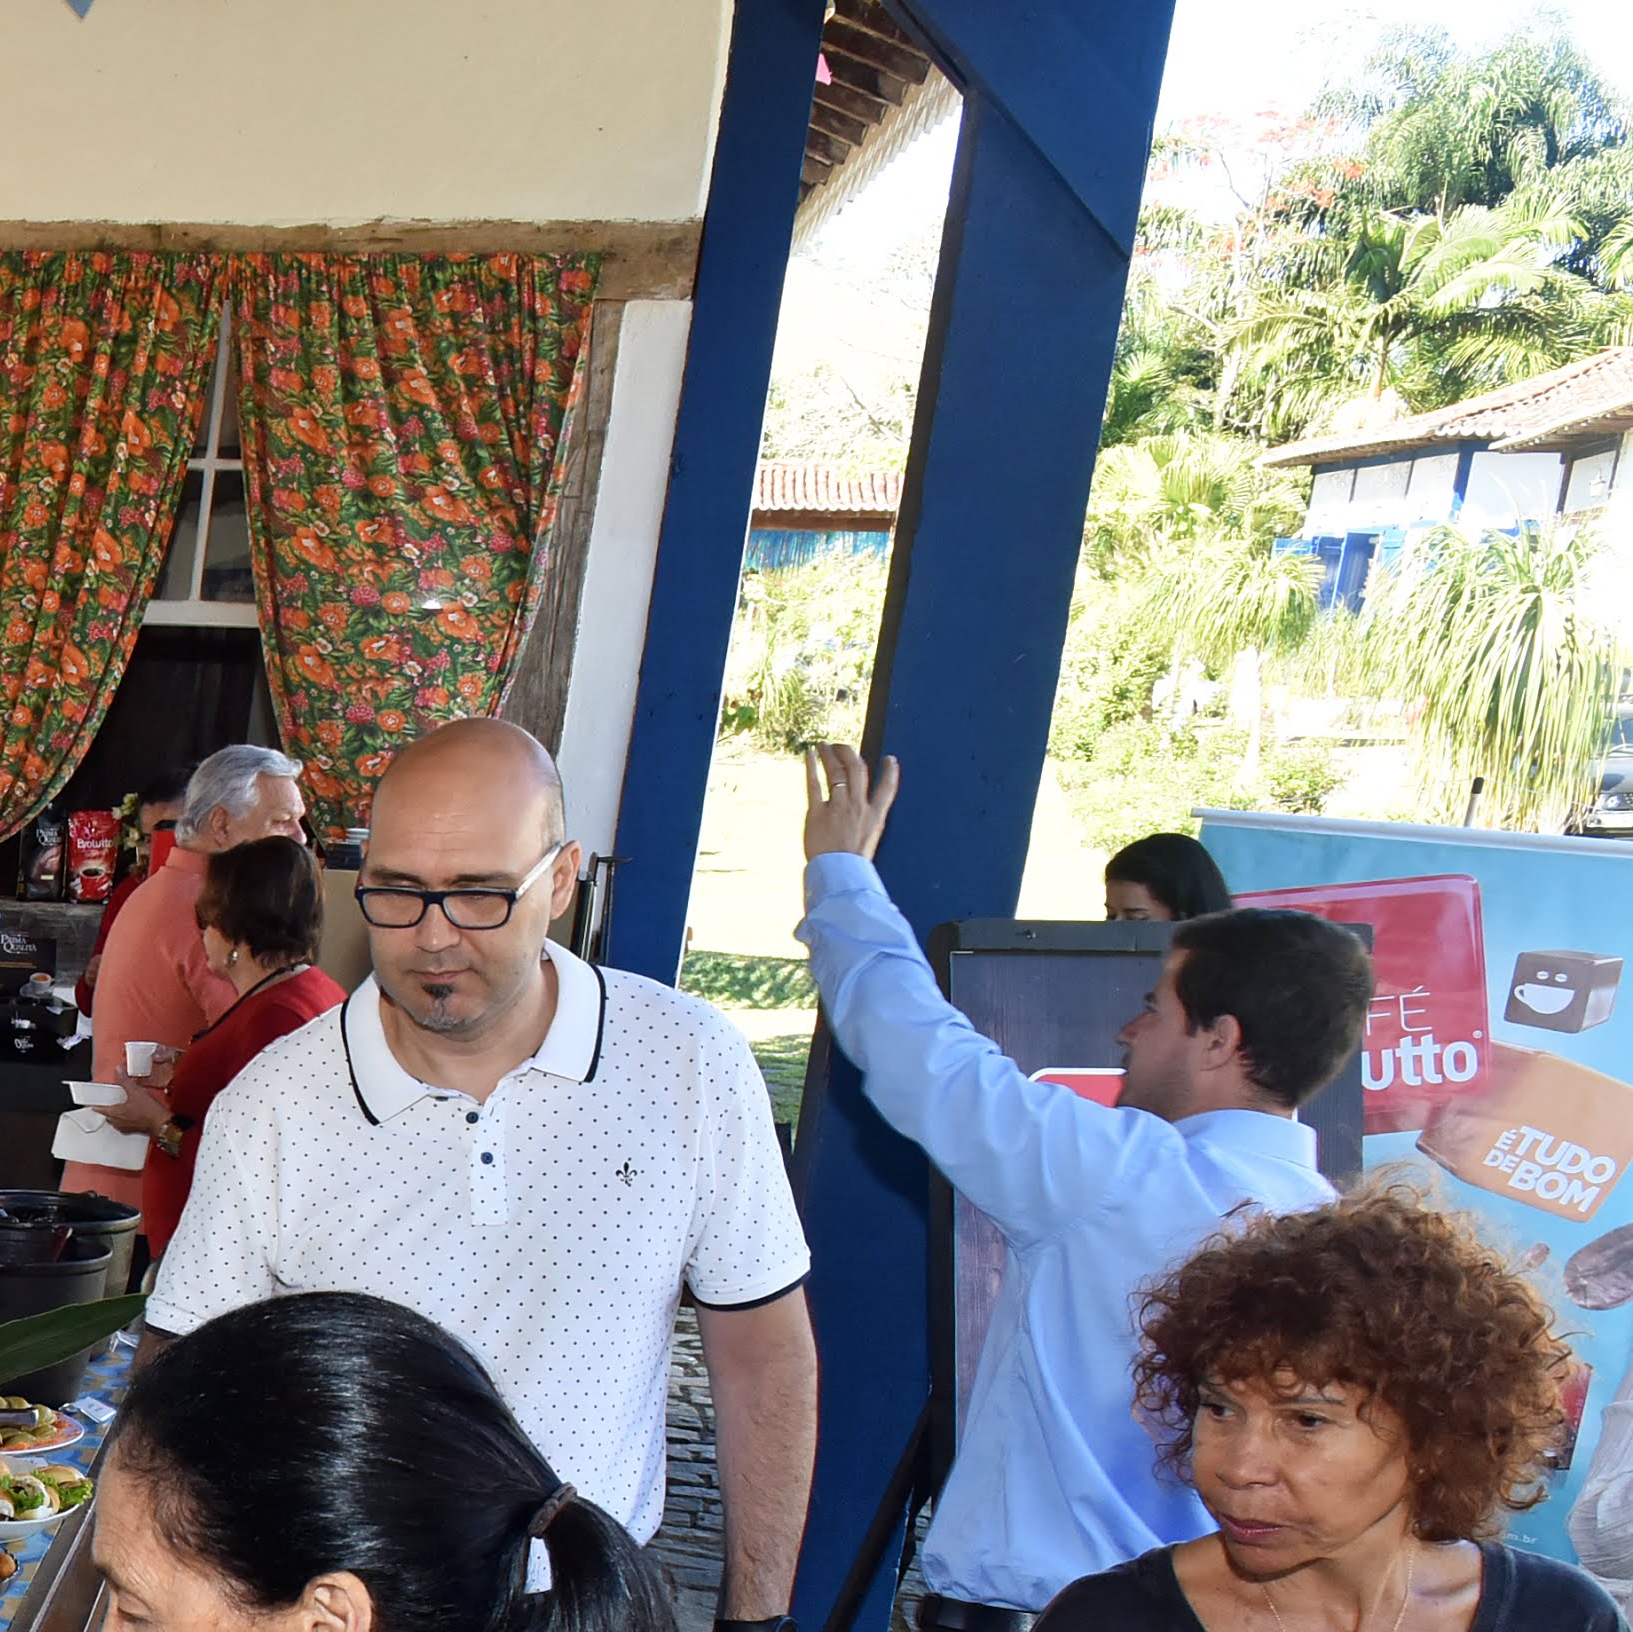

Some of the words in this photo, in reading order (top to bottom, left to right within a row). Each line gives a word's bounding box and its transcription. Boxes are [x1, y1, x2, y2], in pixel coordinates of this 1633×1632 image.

[1483, 1150, 1519, 1174] DE
[1507, 1159, 1601, 1213] BOM
[1494, 1128, 1519, 1151] É
[1514, 1125, 1616, 1184] TUDO
